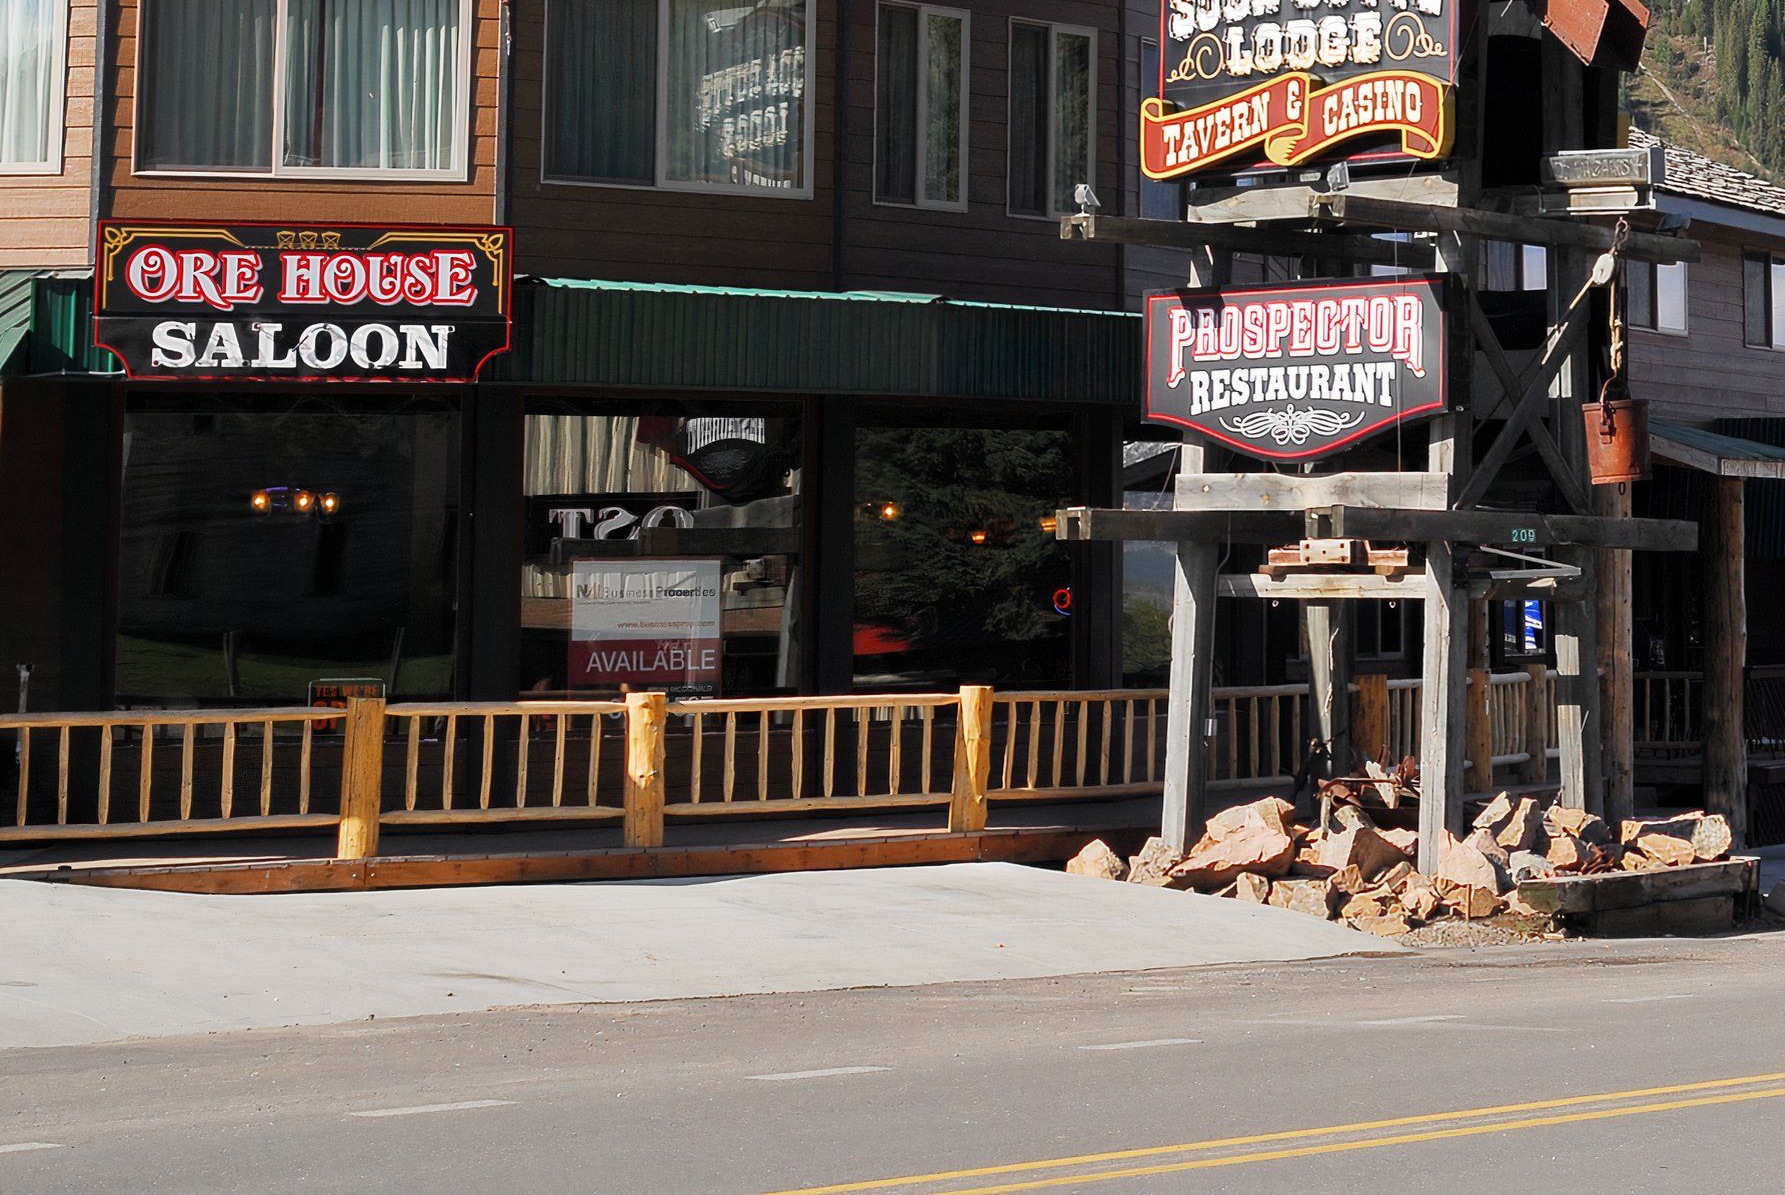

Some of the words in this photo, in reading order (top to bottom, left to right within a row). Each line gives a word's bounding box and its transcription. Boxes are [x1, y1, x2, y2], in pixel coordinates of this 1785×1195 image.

[1224, 11, 1382, 76] LODGE
[1161, 91, 1271, 166] TAVERN
[1286, 80, 1302, 120] &
[1321, 80, 1423, 137] CASINO
[125, 244, 263, 312] ORE
[278, 250, 479, 307] HOUSE
[151, 321, 456, 370] SALOON
[1167, 293, 1426, 389] PROSPECTOR
[1189, 361, 1396, 416] RESTAURANT
[1511, 529, 1536, 542] 209
[586, 649, 716, 673] AVAILABLE
